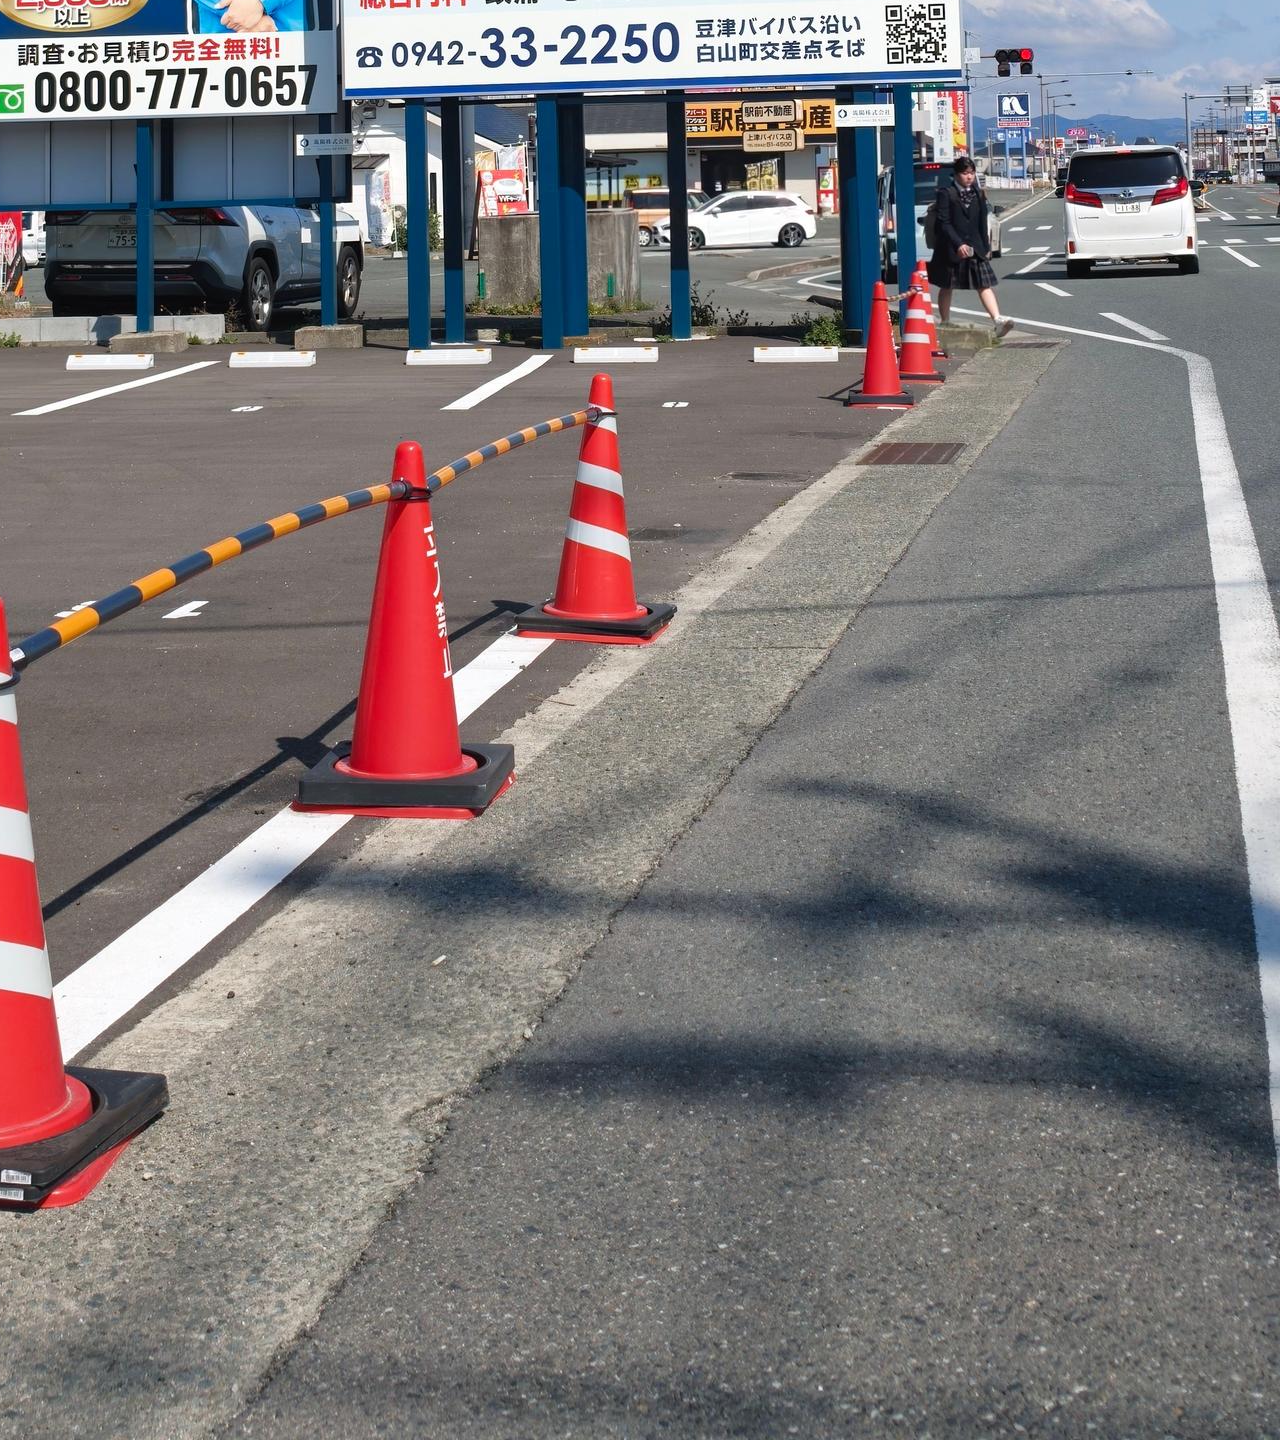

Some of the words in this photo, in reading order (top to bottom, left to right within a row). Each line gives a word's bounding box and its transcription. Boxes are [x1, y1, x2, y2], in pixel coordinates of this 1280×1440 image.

[54, 8, 90, 26] 以上
[695, 16, 861, 38] 豆津バイパス沿い
[391, 21, 680, 69] 0942-33-2250
[696, 39, 865, 63] 白山町交差点そば
[34, 64, 318, 113] 0800-777-0657
[744, 105, 793, 118] 駅前不動産
[746, 133, 793, 142] 上津バイパス店
